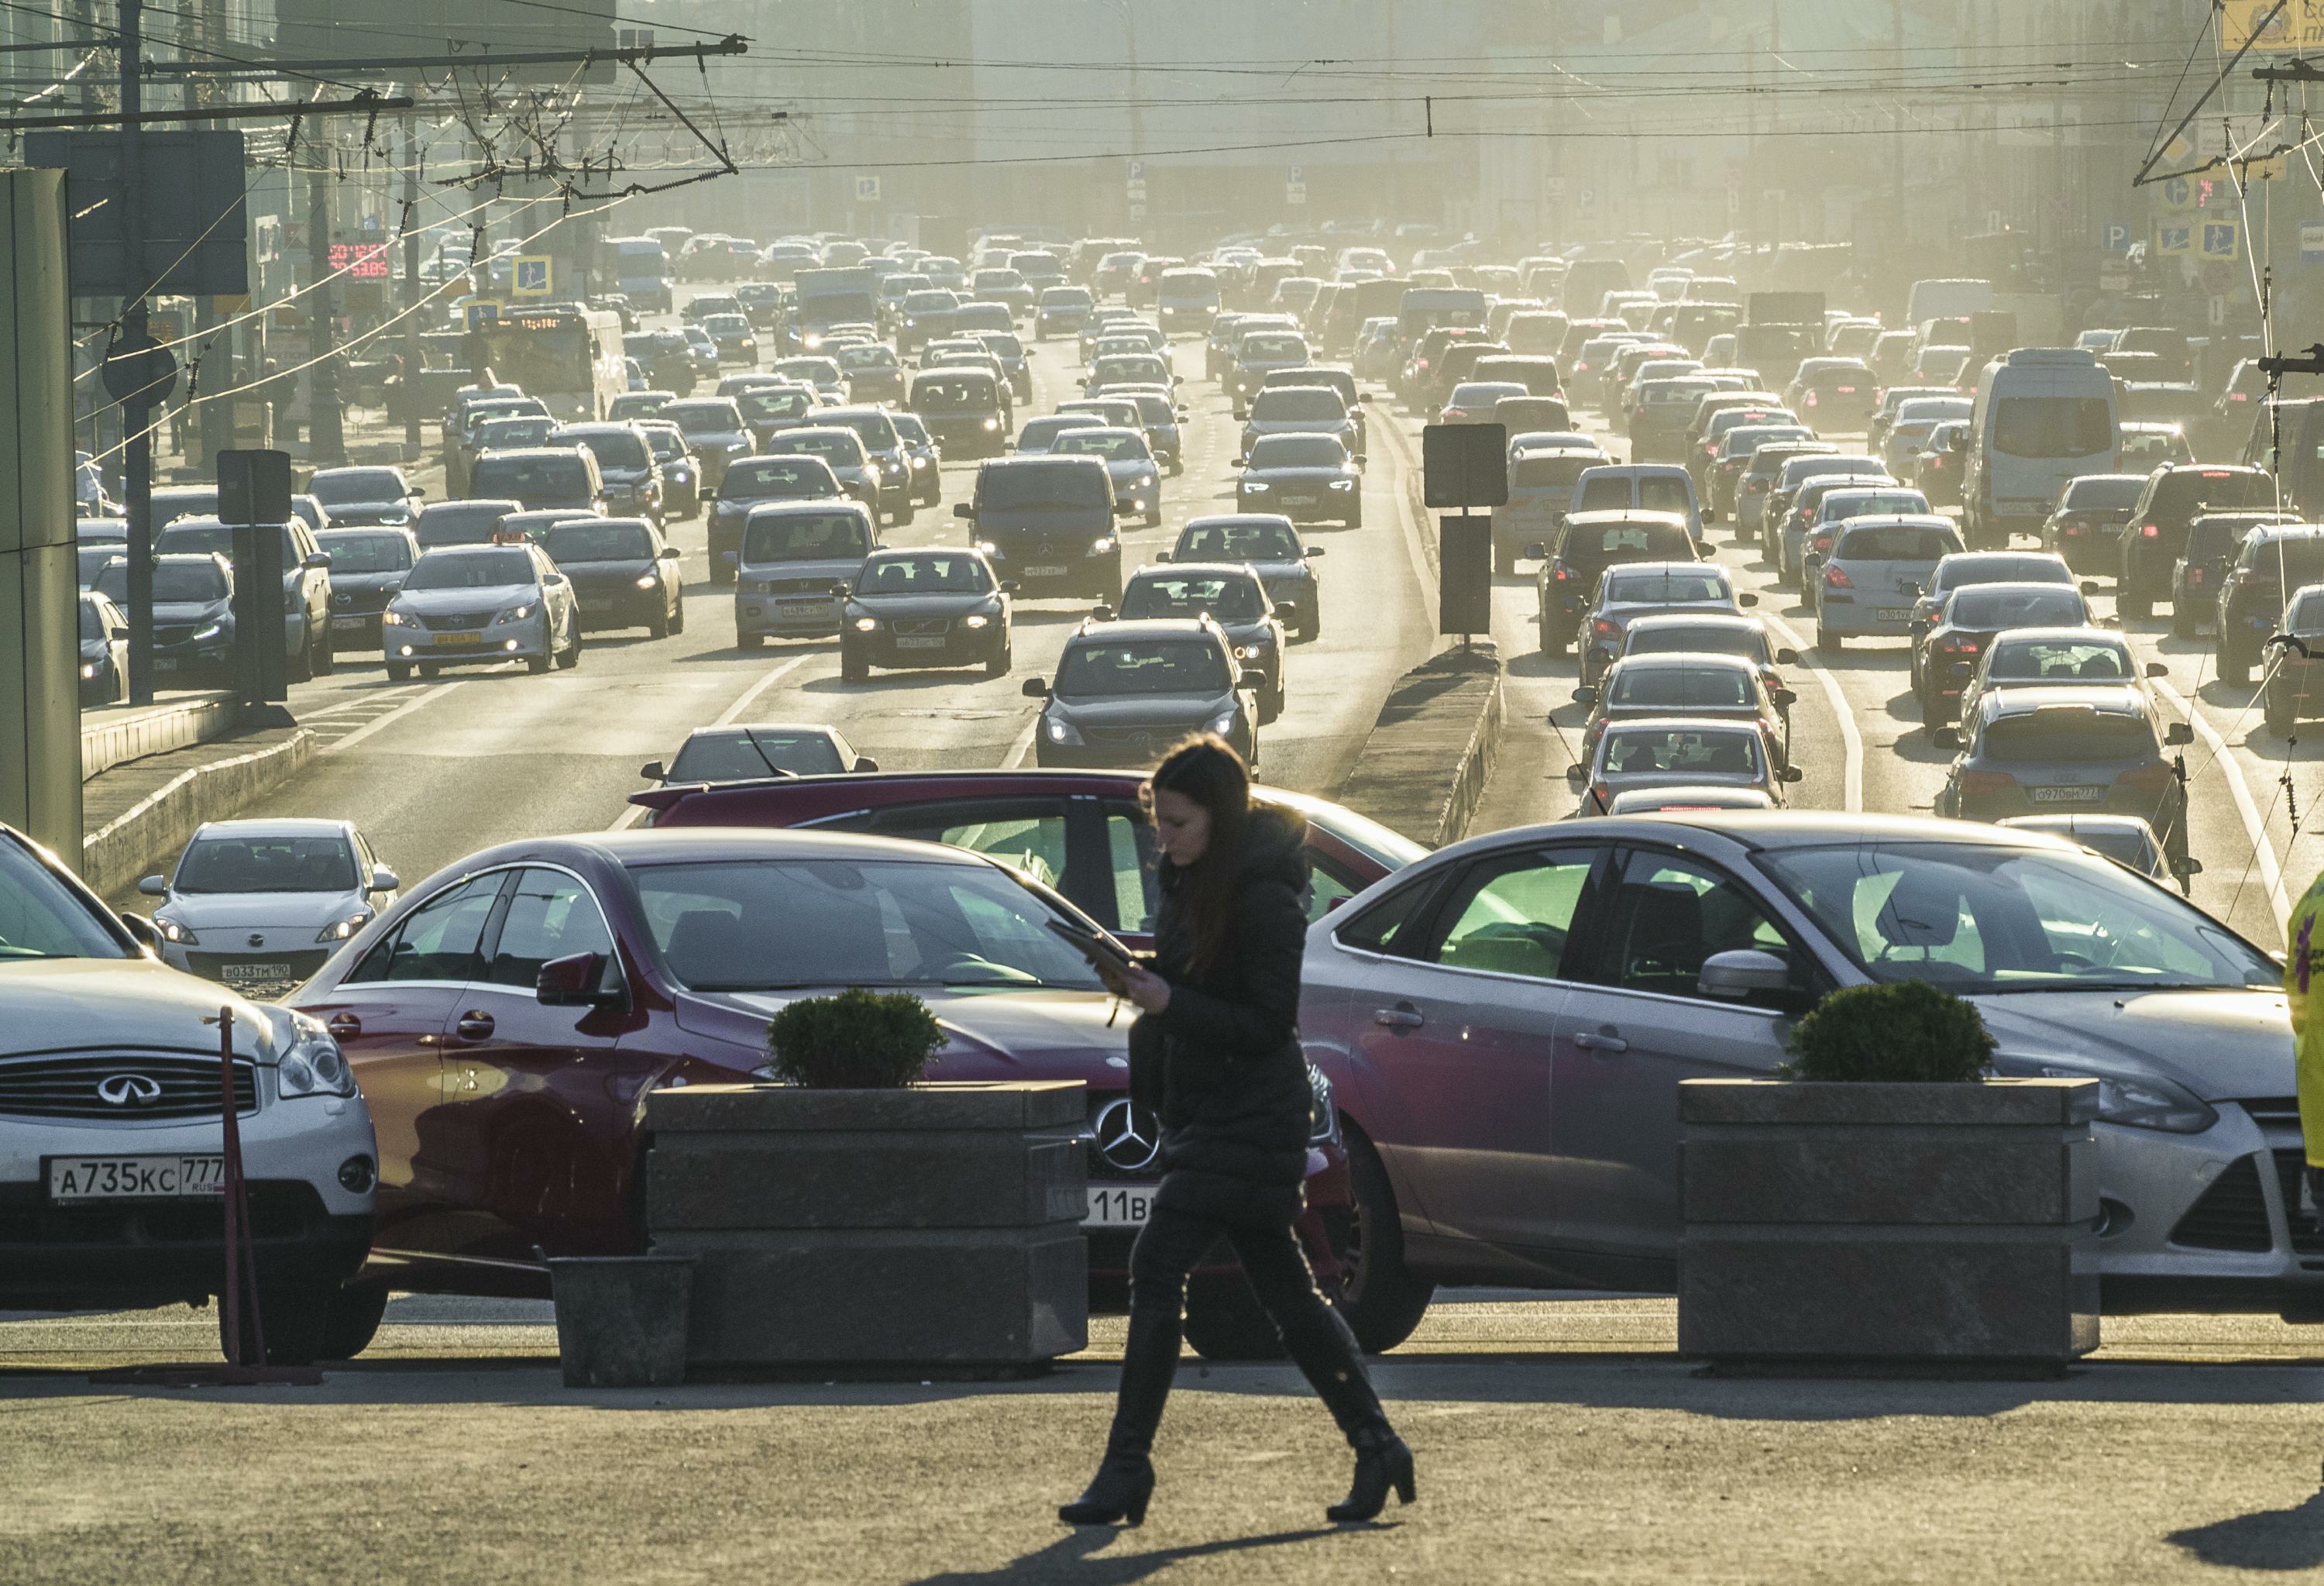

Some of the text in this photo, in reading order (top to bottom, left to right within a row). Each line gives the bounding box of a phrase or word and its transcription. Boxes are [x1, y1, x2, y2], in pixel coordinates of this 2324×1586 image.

[1131, 163, 1140, 178] P
[1291, 167, 1301, 182] P
[2109, 226, 2125, 248] P
[226, 965, 287, 977] В033ТМ 190
[60, 1158, 224, 1193] А735КС 777
[192, 1183, 212, 1192] RUS
[1085, 1190, 1154, 1221] 11В
